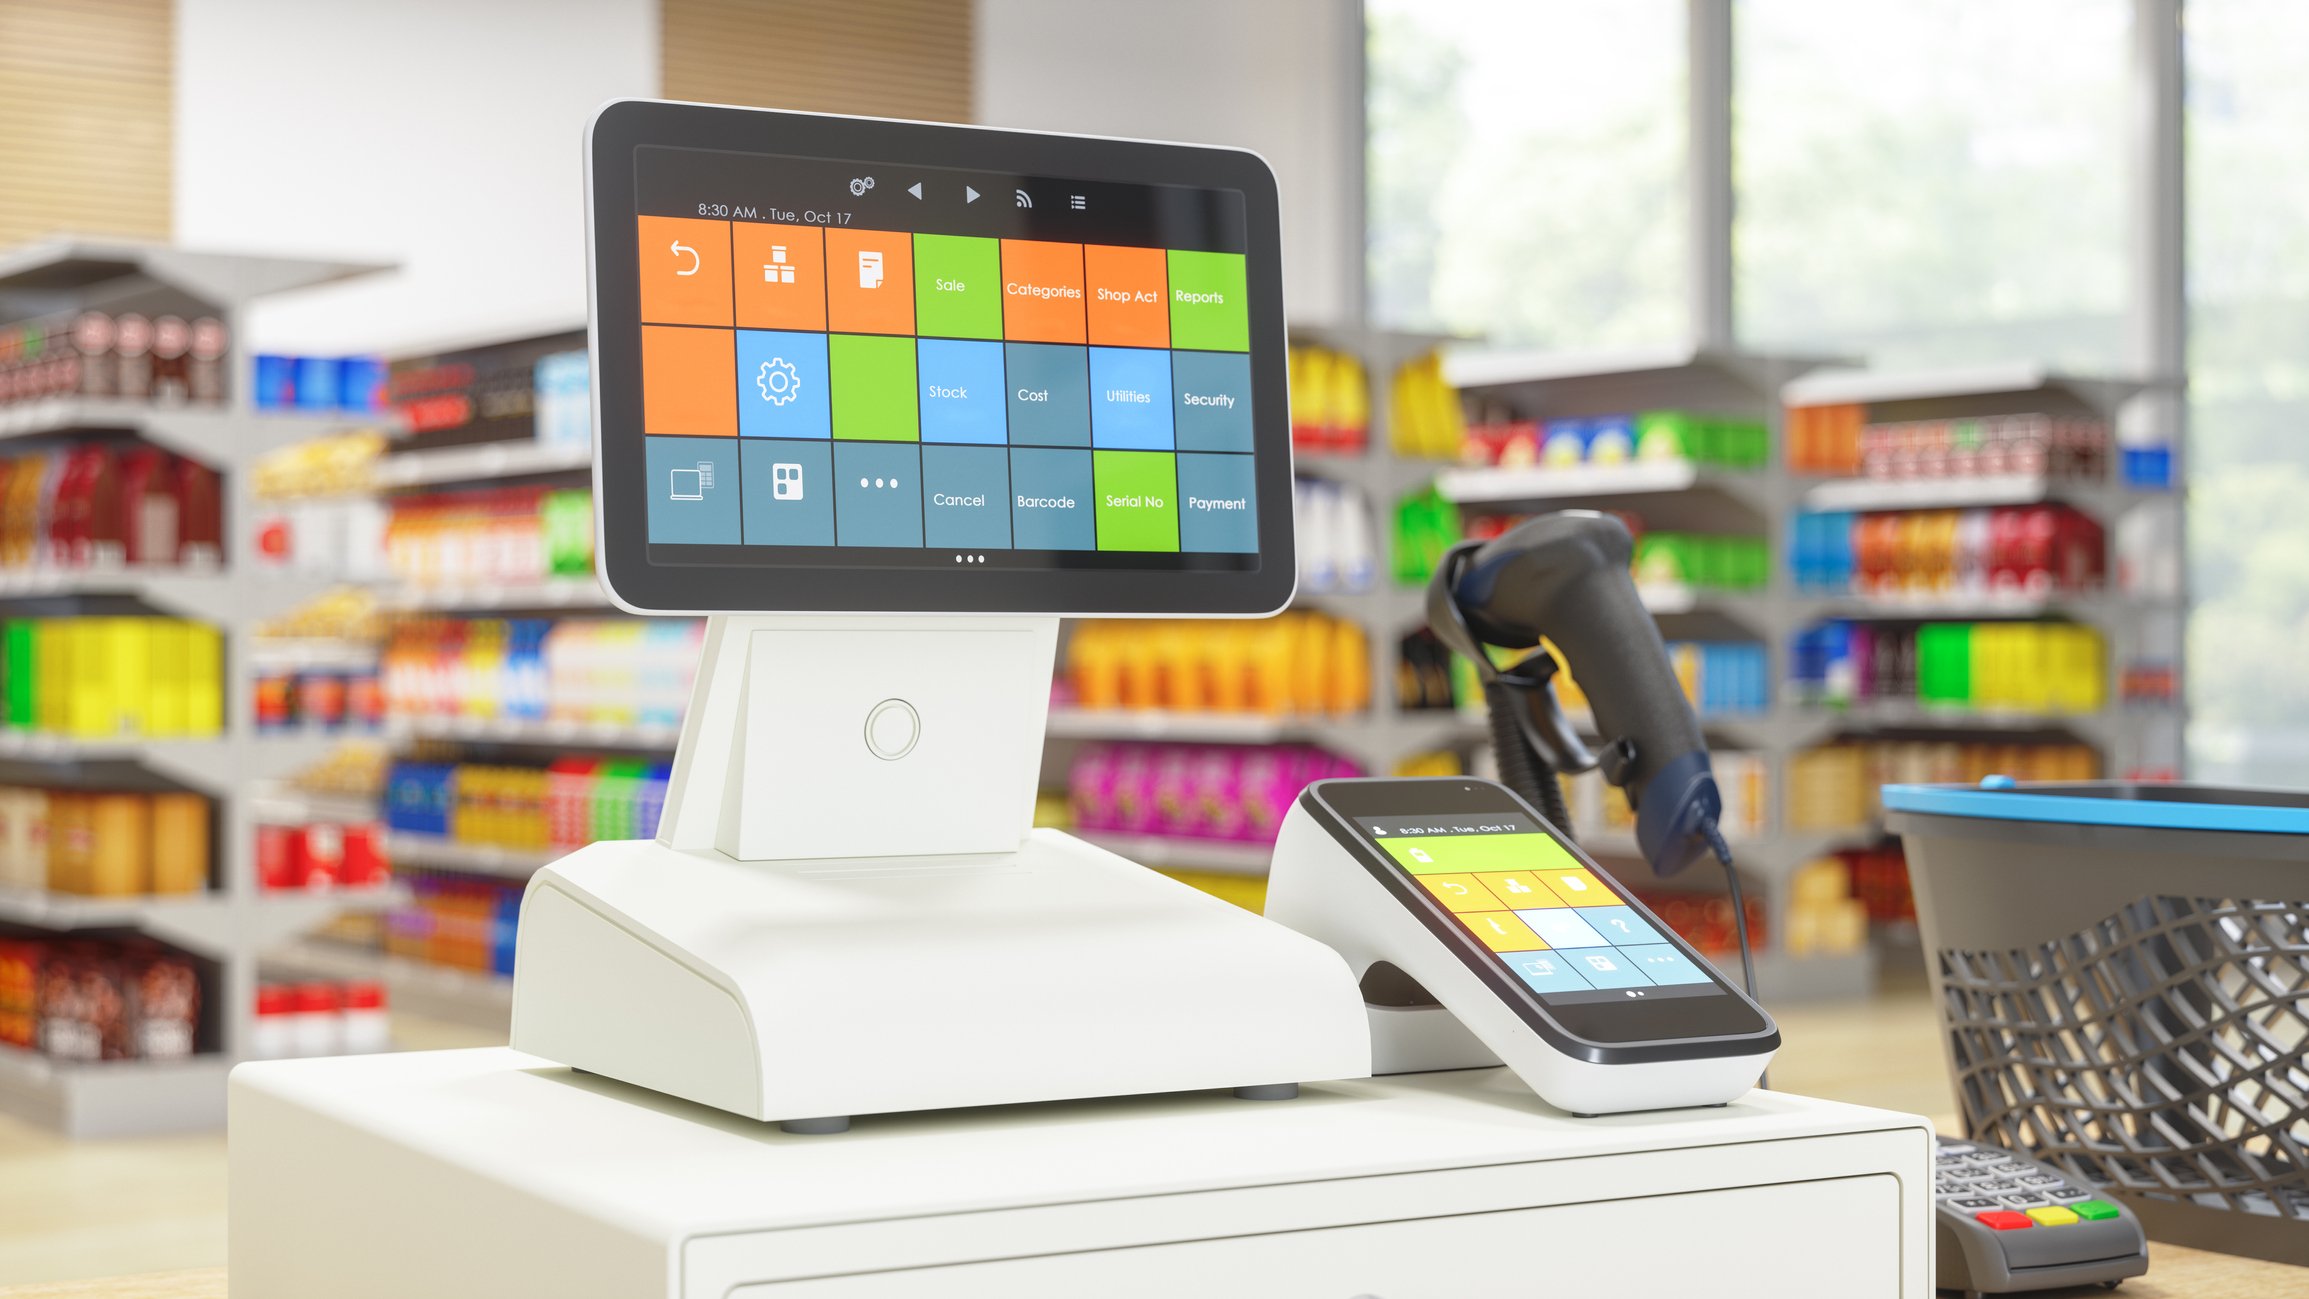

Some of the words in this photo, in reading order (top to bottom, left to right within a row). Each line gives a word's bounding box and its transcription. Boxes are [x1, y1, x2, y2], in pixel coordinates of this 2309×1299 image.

[698, 203, 729, 217] 8:30
[732, 206, 757, 219] AM
[769, 207, 800, 223] Tue,
[804, 210, 832, 224] Oct
[836, 212, 852, 225] 17
[935, 278, 966, 292] Sale
[1006, 282, 1081, 300] Categories
[1097, 287, 1131, 304] Shop
[1134, 290, 1158, 304] Act
[1175, 289, 1224, 305] Reports
[929, 385, 968, 399] Stock
[1017, 388, 1049, 402] Cost
[1106, 389, 1151, 404] Utilities
[1184, 392, 1235, 409] Security
[933, 493, 985, 507] Cancel
[1017, 495, 1075, 509] Barcode
[1105, 494, 1142, 508] Serial
[1144, 495, 1164, 509] No
[1188, 496, 1246, 512] Payment
[1427, 826, 1448, 834] AM
